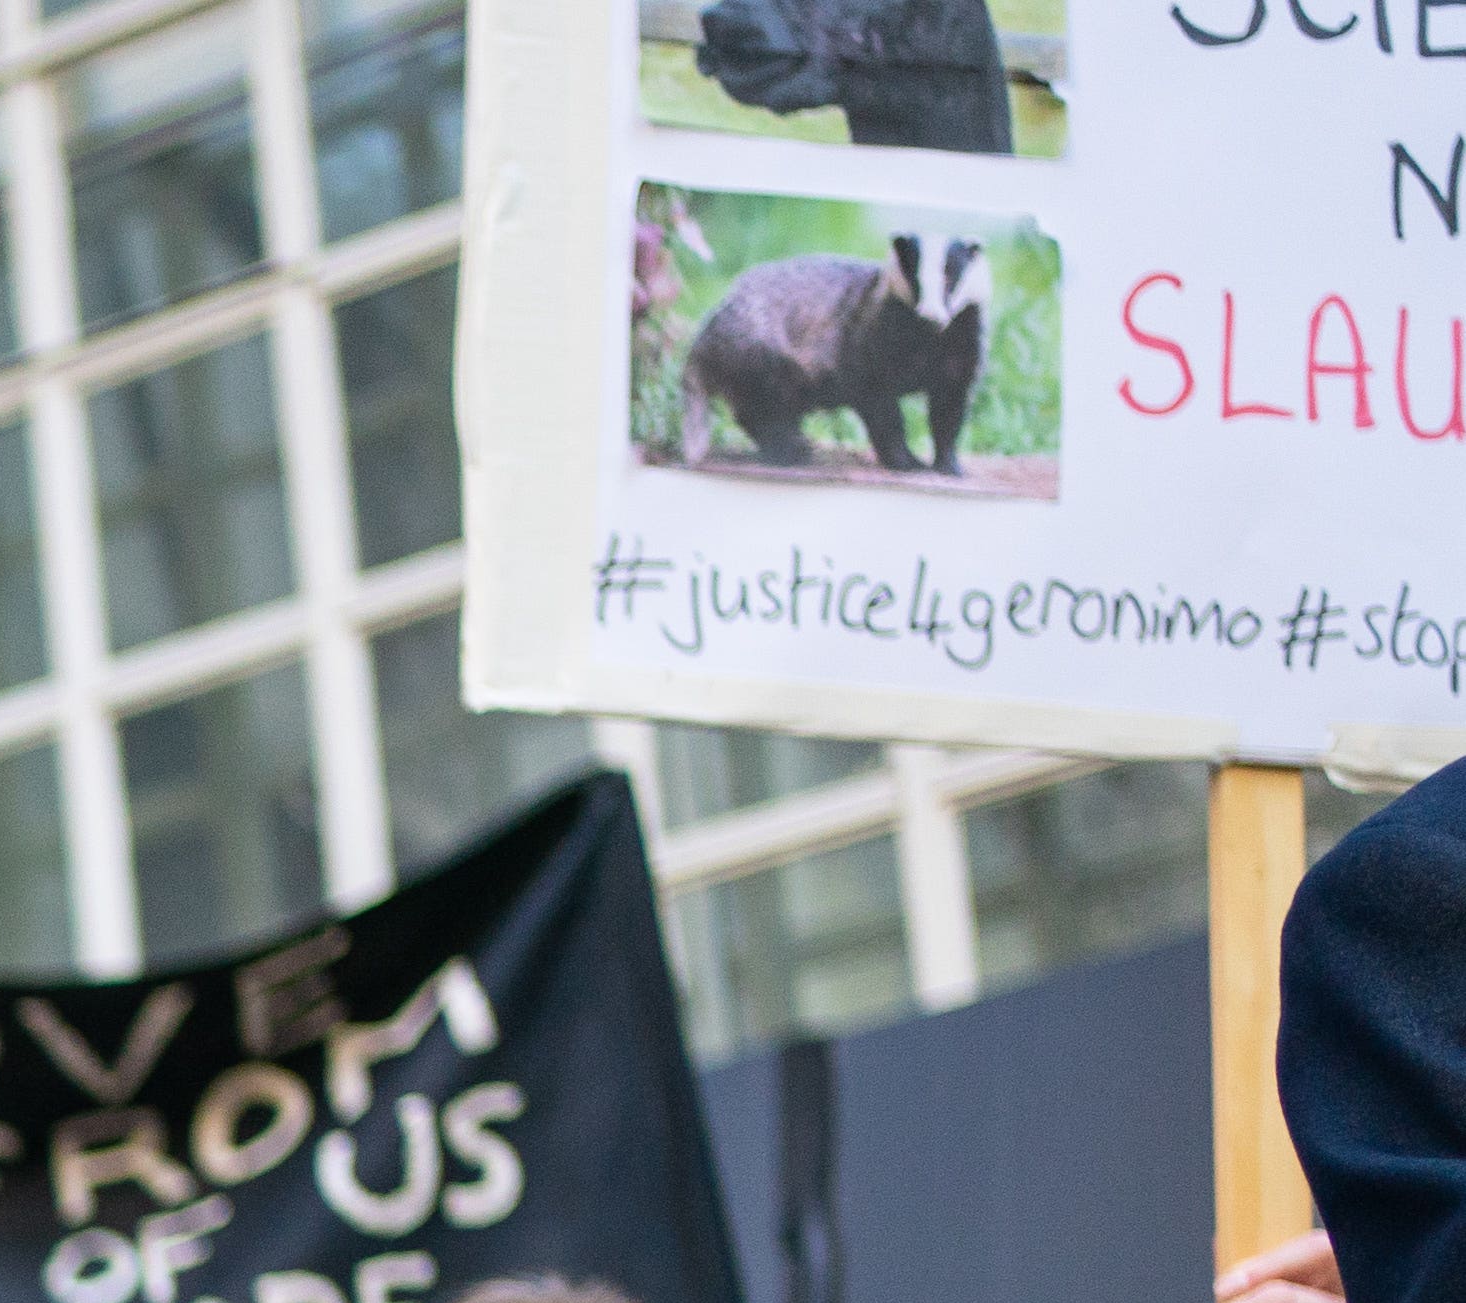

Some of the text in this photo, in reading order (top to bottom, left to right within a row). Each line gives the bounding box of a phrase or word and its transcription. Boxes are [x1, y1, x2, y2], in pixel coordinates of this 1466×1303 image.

[1117, 272, 1466, 442] SLAU
[594, 534, 1263, 670] #justice4geronimo
[314, 1080, 526, 1240] US
